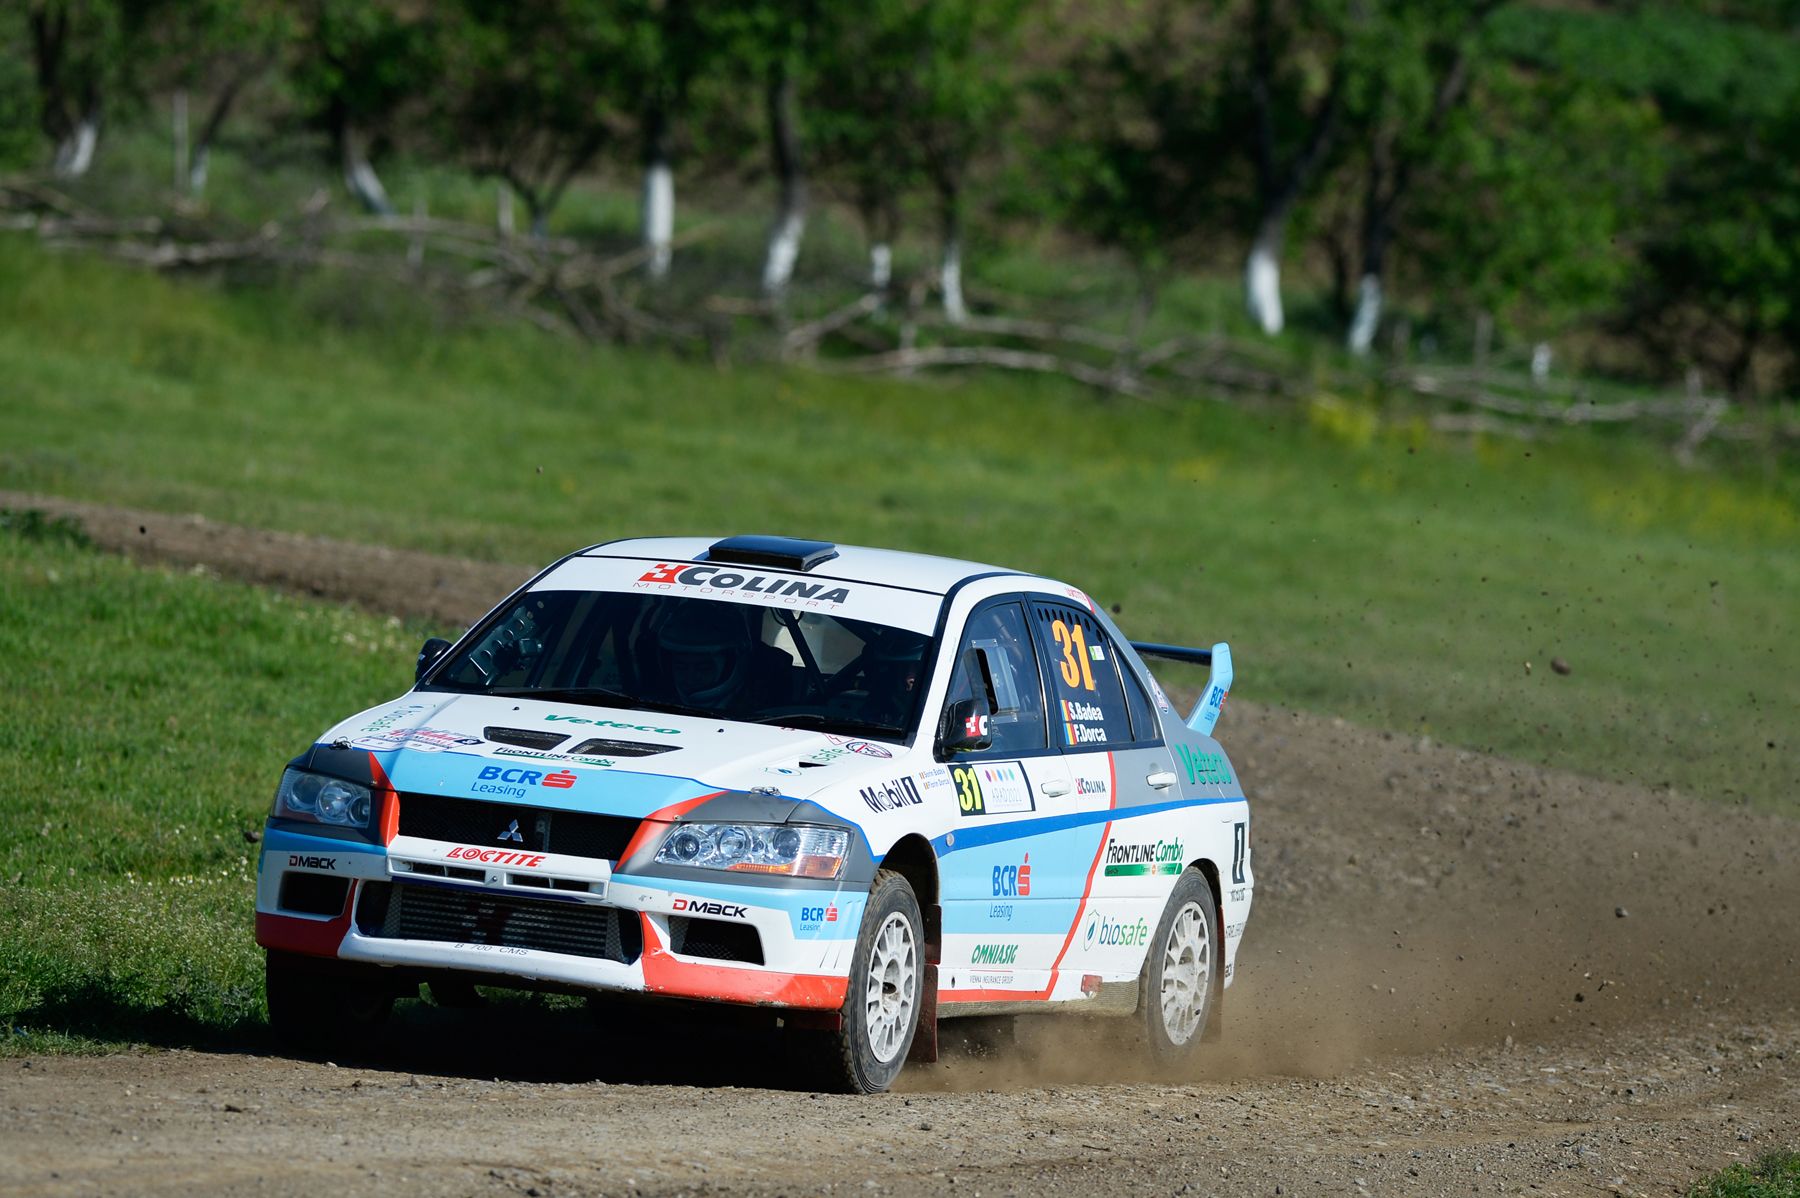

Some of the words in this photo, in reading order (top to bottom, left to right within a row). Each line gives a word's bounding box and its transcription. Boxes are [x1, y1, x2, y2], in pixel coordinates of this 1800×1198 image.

[677, 566, 850, 604] COLINA
[632, 582, 840, 610] MOTORSPORT
[1052, 619, 1095, 691] 31
[1068, 701, 1104, 721] S.Badea
[544, 714, 682, 735] Veteco
[1072, 723, 1107, 743] F.Dorca
[477, 765, 542, 786] BCR
[1080, 777, 1107, 794] COLINA
[470, 781, 527, 799] Leasing
[859, 778, 910, 814] Mobil
[953, 767, 982, 811] 31
[446, 847, 546, 867] LOCTITE
[1105, 838, 1156, 864] FRONTLINE
[992, 865, 1017, 897] BCR
[801, 907, 824, 922] BCR
[989, 902, 1013, 921] Leasing
[1098, 916, 1149, 946] biosafe
[499, 947, 529, 956] CMS
[971, 944, 1019, 965] OMNIASIG
